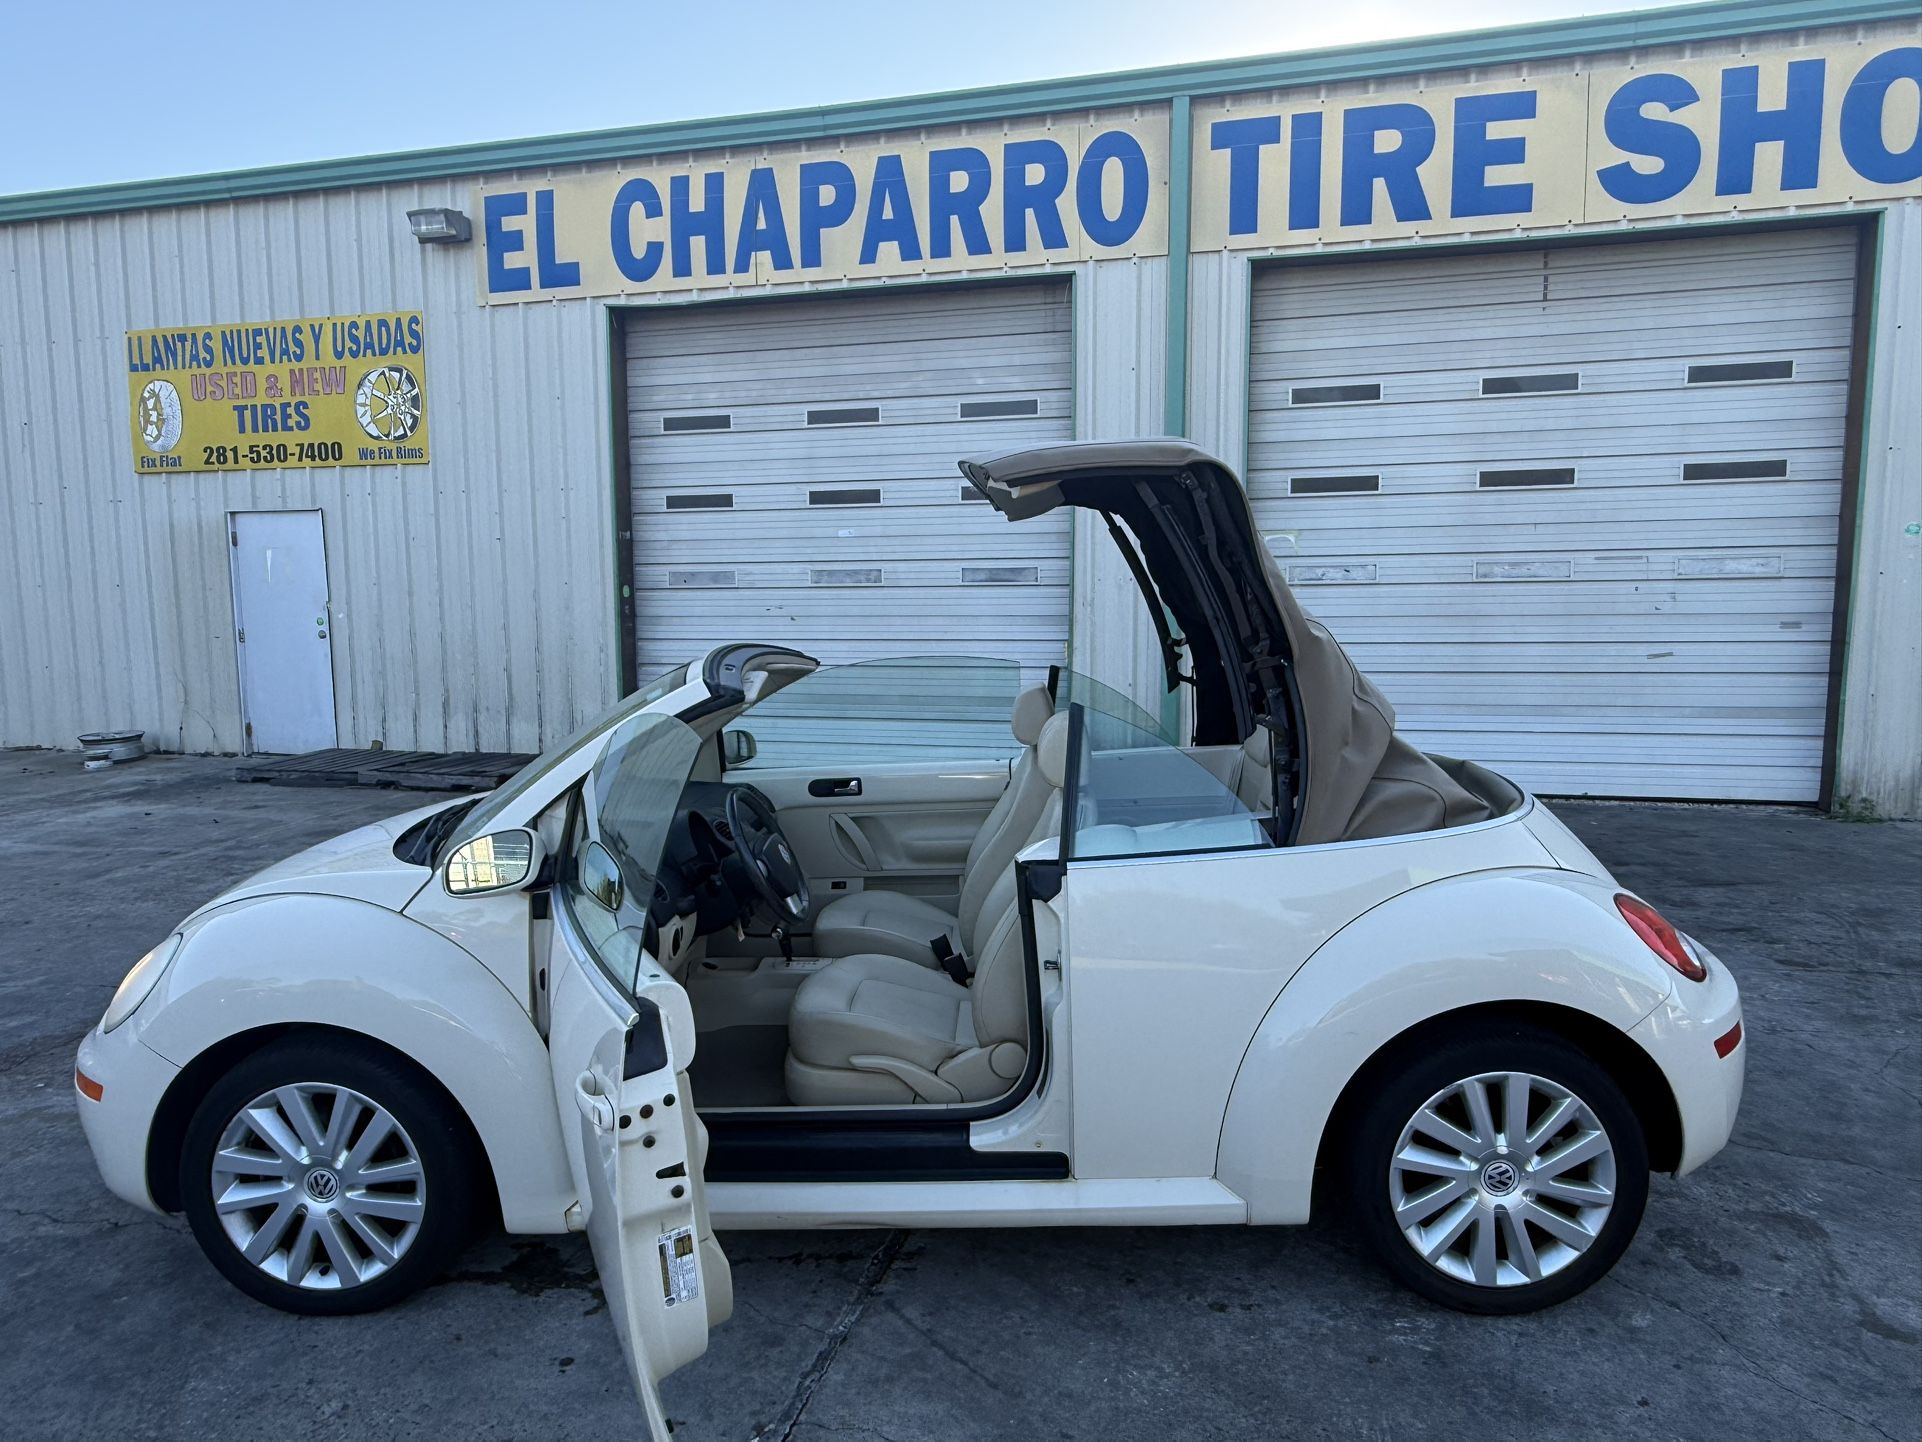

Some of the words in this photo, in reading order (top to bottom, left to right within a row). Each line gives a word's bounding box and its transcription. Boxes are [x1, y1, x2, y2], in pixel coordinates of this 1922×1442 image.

[484, 189, 580, 293] EL
[611, 130, 1149, 282] CHAPARRO
[1211, 90, 1537, 235] TIRE
[1597, 47, 1922, 204] SHO
[128, 332, 214, 372] LLANTAS
[221, 324, 304, 367] NUEVAS
[310, 323, 324, 360] Y
[332, 315, 422, 361] USADAS
[190, 371, 257, 401] USED
[265, 373, 283, 399] &
[289, 366, 347, 397] NEW
[232, 401, 311, 434] TIRES
[140, 456, 158, 468] Fix
[159, 454, 182, 468] Flat
[203, 441, 343, 466] 281-530-7400
[358, 446, 376, 461] We
[377, 446, 394, 461] Fix
[396, 446, 424, 460] Rims
